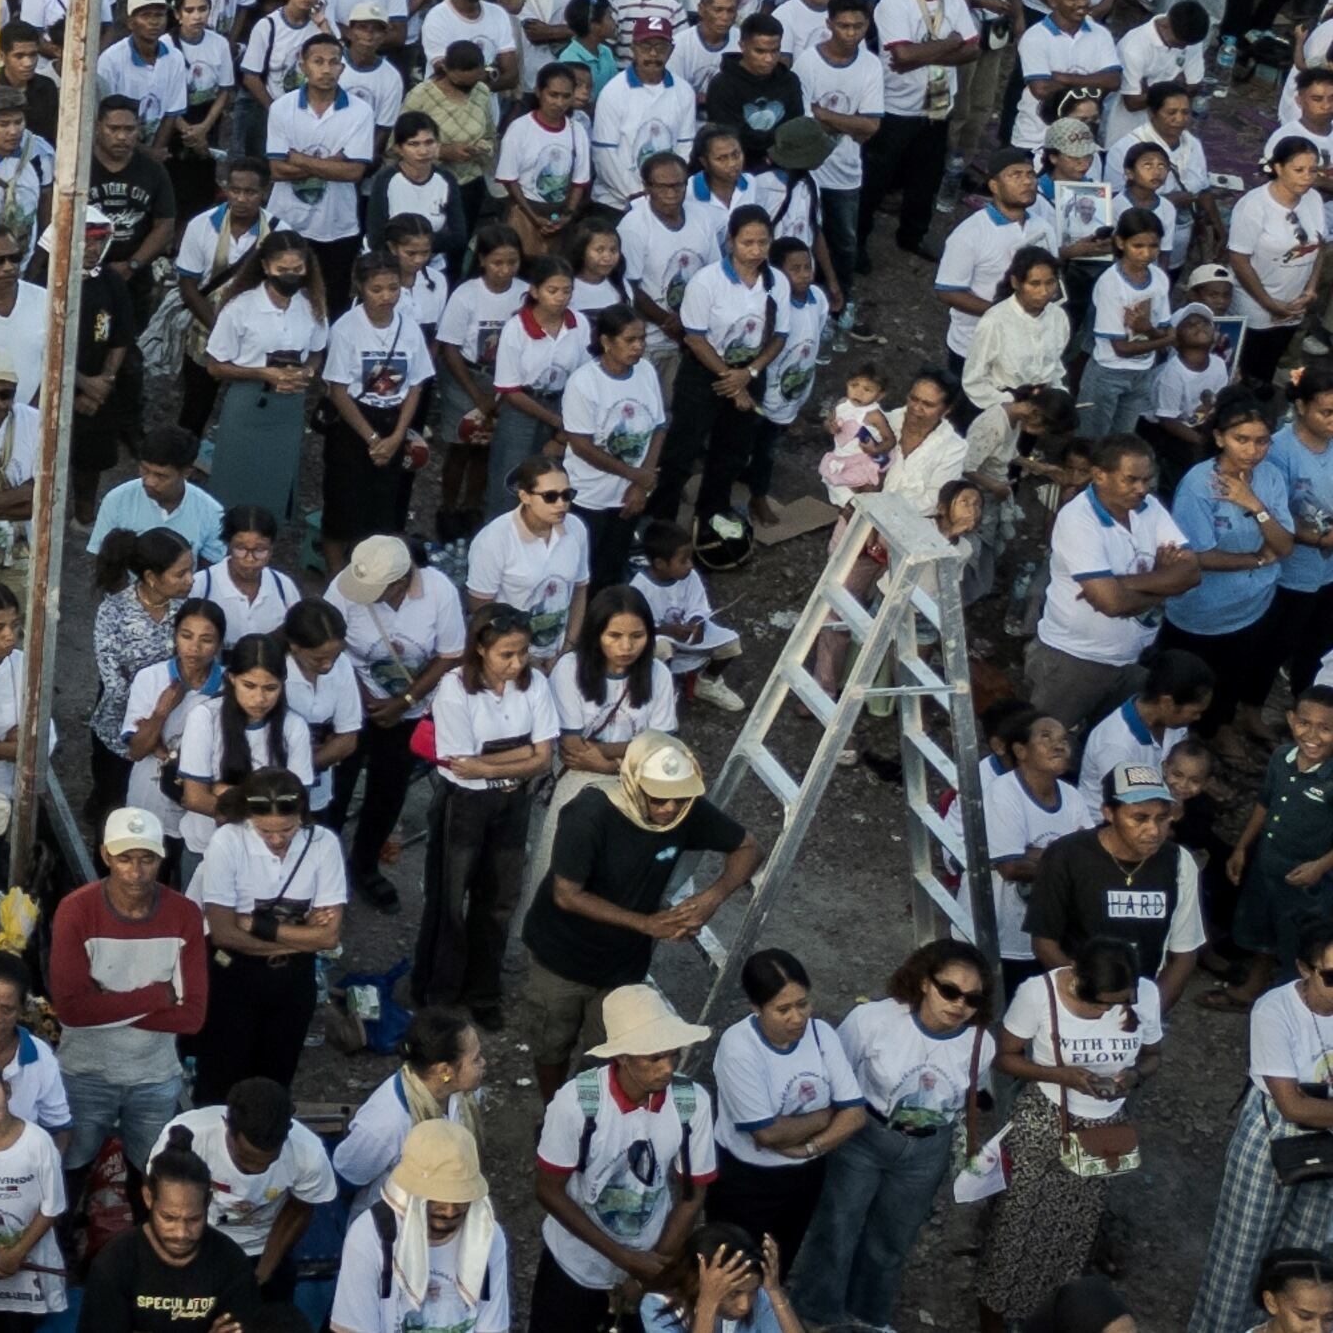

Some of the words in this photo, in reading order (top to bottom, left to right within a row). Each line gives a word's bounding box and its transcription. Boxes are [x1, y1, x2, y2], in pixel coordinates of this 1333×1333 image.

[1110, 893, 1165, 916] HARD
[1108, 1037, 1140, 1051] THE
[1072, 1052, 1129, 1064] FLOW
